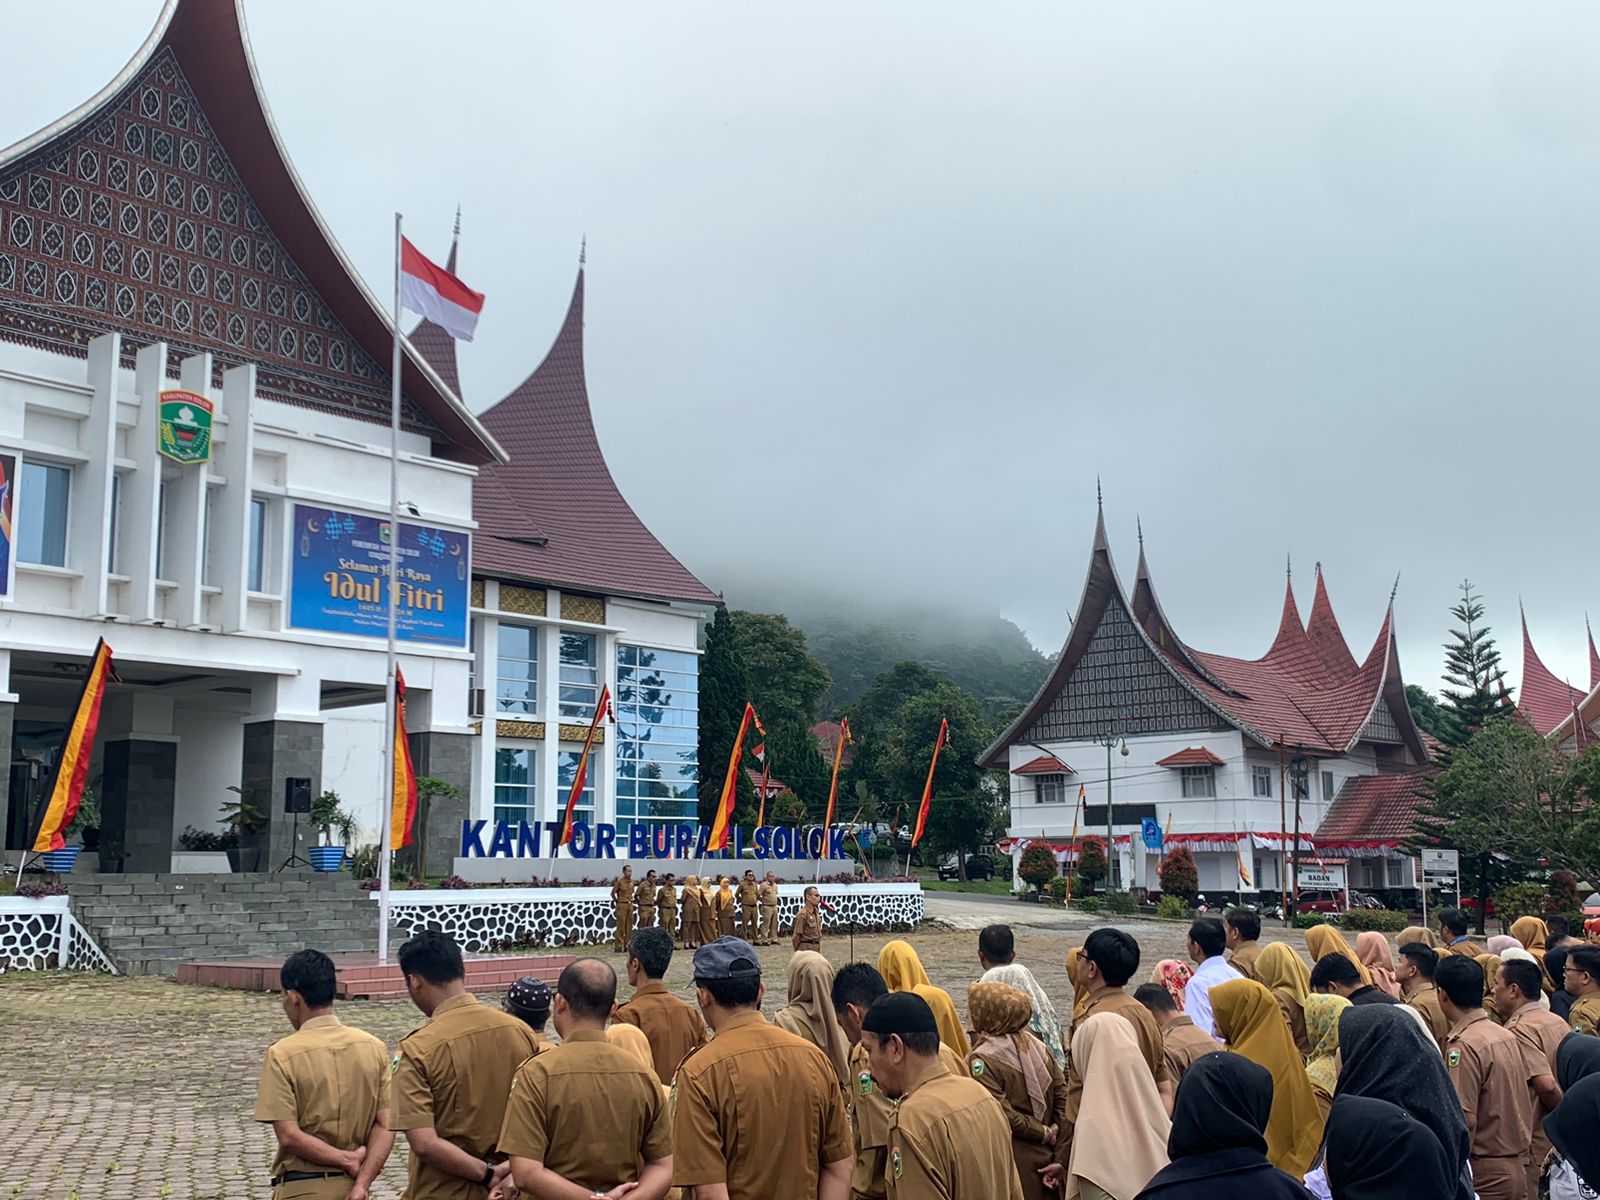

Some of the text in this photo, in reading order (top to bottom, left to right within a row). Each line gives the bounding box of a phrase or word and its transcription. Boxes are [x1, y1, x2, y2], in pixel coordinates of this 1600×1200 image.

[338, 557, 432, 582] Selamat Hri Raya
[323, 571, 381, 603] Idul
[387, 581, 444, 612] Fitri
[460, 819, 616, 859] KANTOR
[752, 825, 847, 860] SOLOK
[1308, 874, 1330, 882] BADAN
